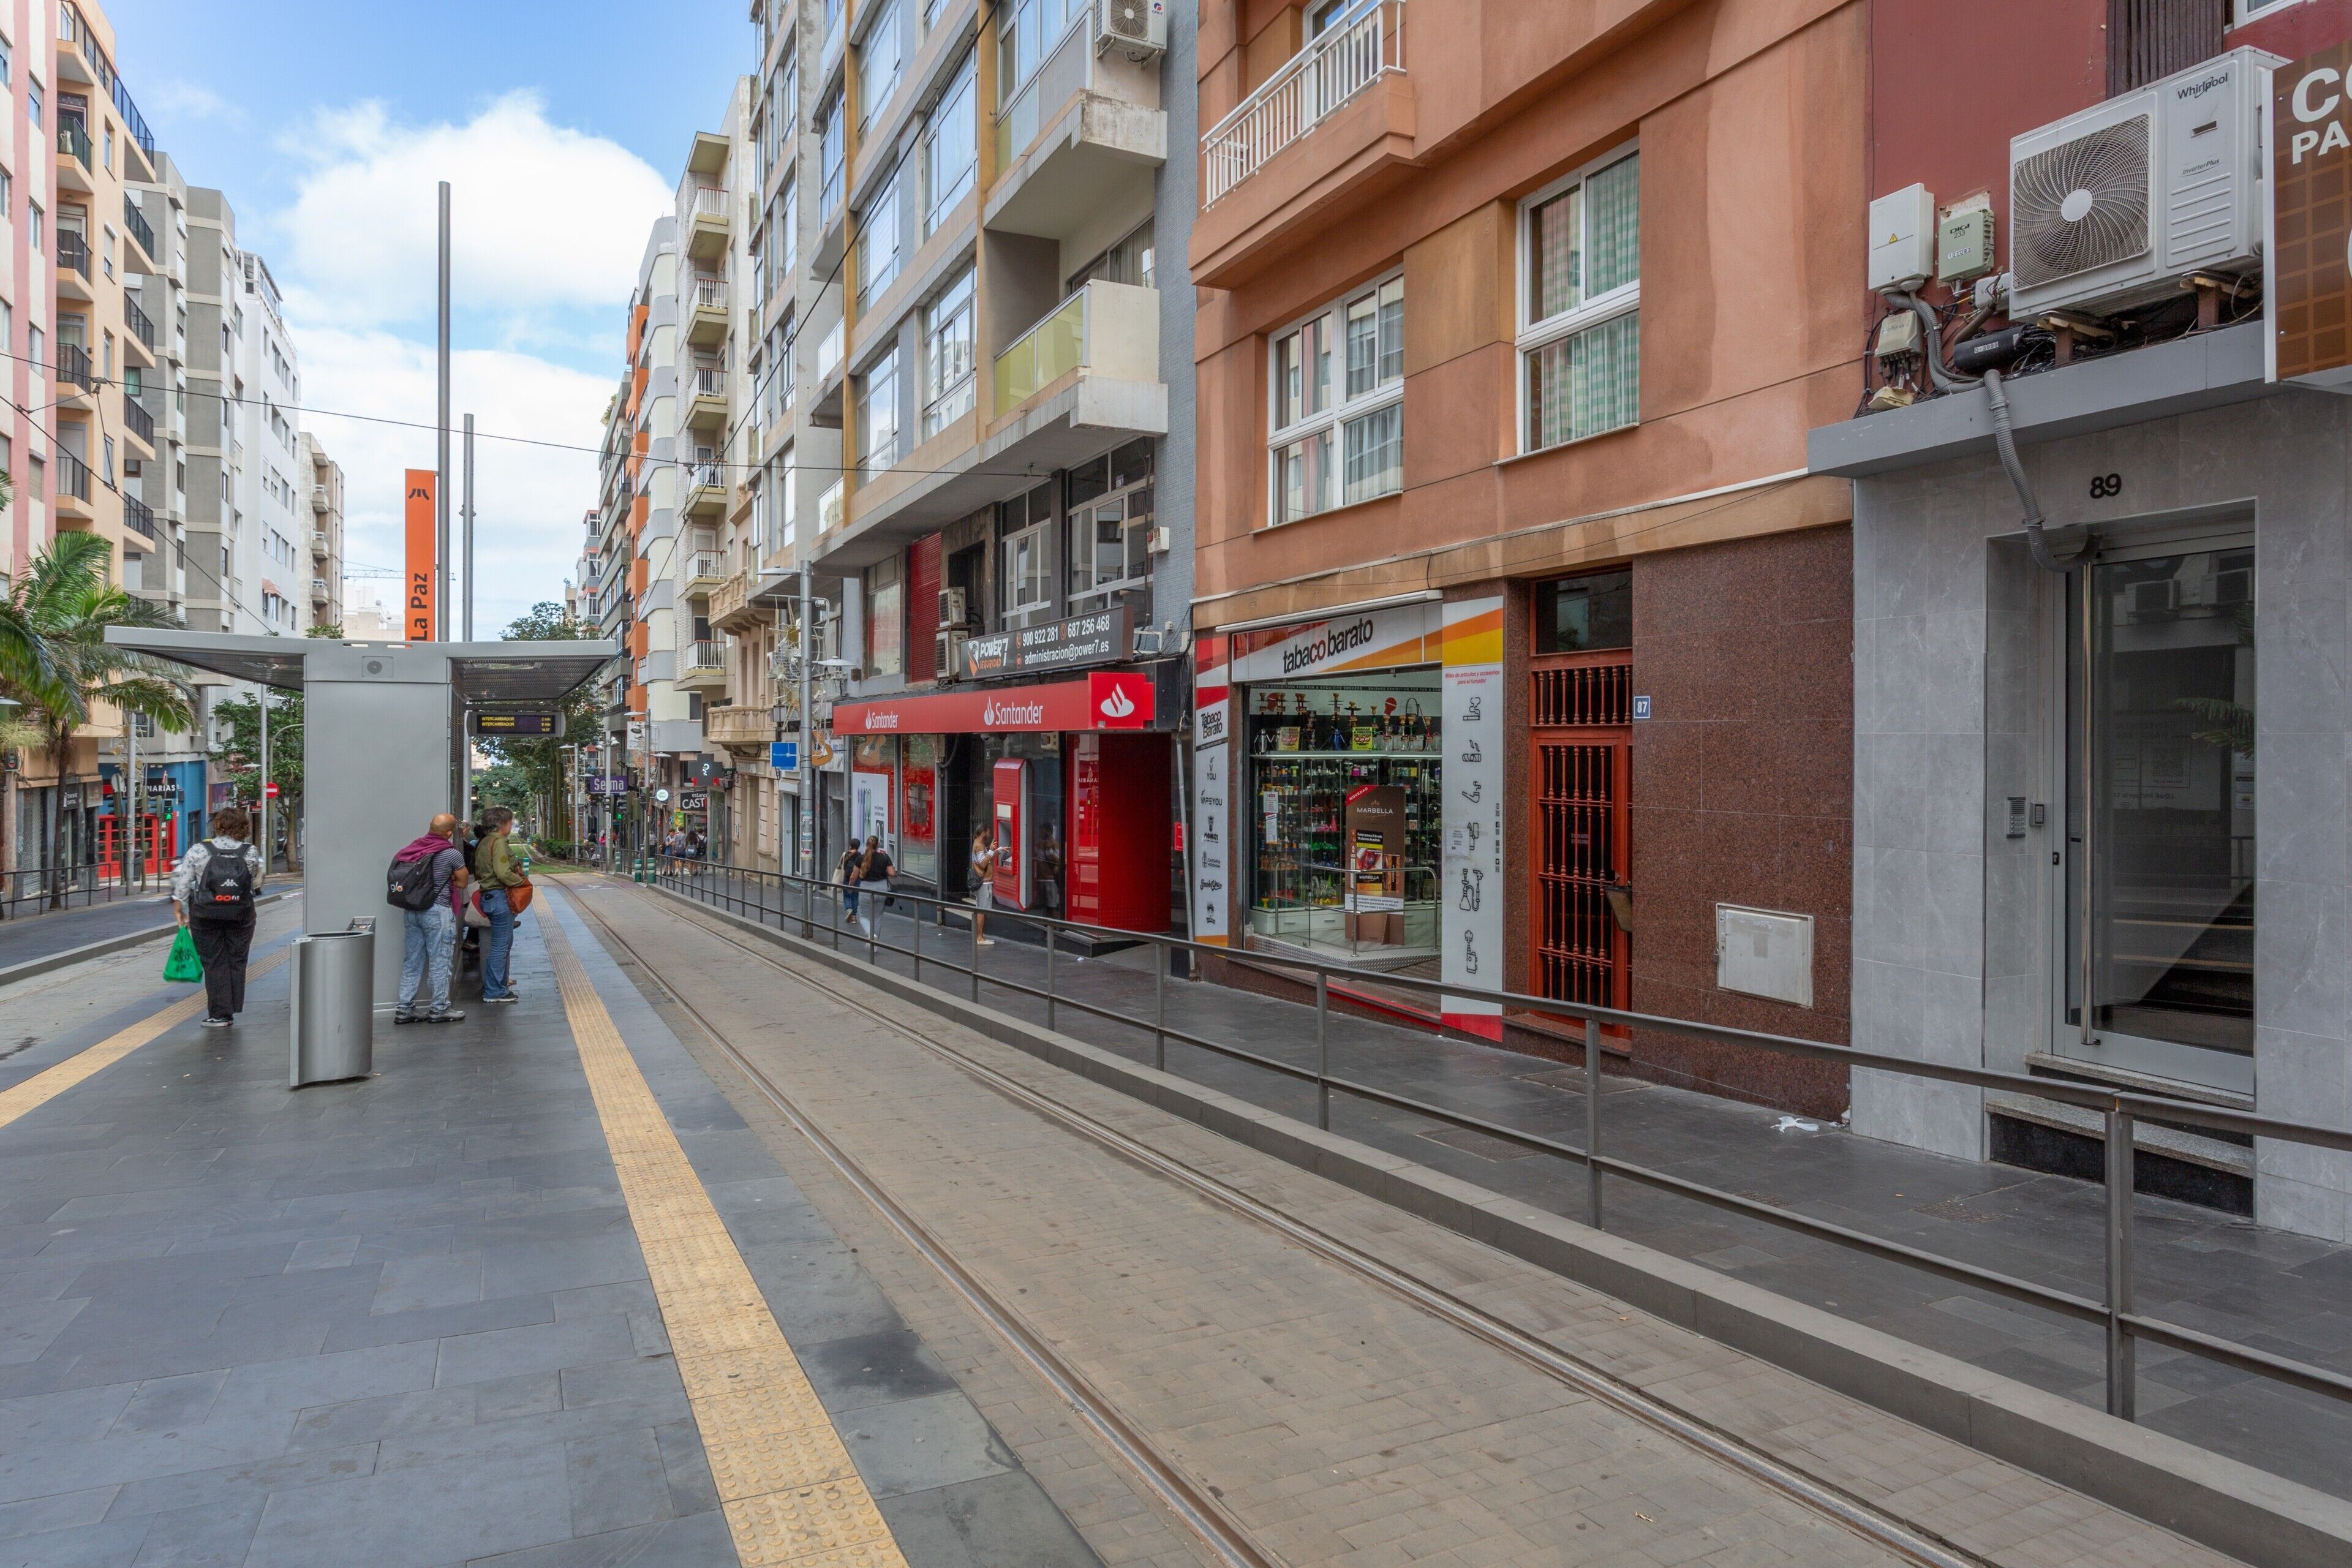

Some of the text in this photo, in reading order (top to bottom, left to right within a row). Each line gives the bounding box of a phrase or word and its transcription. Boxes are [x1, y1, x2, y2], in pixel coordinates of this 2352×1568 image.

[2177, 72, 2228, 99] Whirlpool
[2292, 67, 2352, 123] C
[2292, 120, 2351, 165] PA
[2182, 159, 2220, 175] InverterPlus
[1950, 223, 1970, 234] DIGI
[1954, 230, 1966, 239] 233
[2090, 473, 2122, 499] 89
[411, 573, 428, 641] La Paz
[1068, 614, 1110, 638] 687 256 468
[1022, 626, 1058, 647] 900 922 281
[1283, 617, 1373, 674] tabaco barato
[980, 638, 1001, 658] POWER
[1025, 639, 1109, 665] administracion@power7.es
[995, 701, 1043, 725] Santander
[1637, 701, 1648, 714] 87
[872, 711, 899, 729] Santander
[1201, 711, 1221, 727] Tabaco
[1203, 722, 1223, 739] Barato
[594, 778, 624, 791] Sema
[1349, 786, 1368, 801] NOVEDAD
[390, 881, 403, 893] glo
